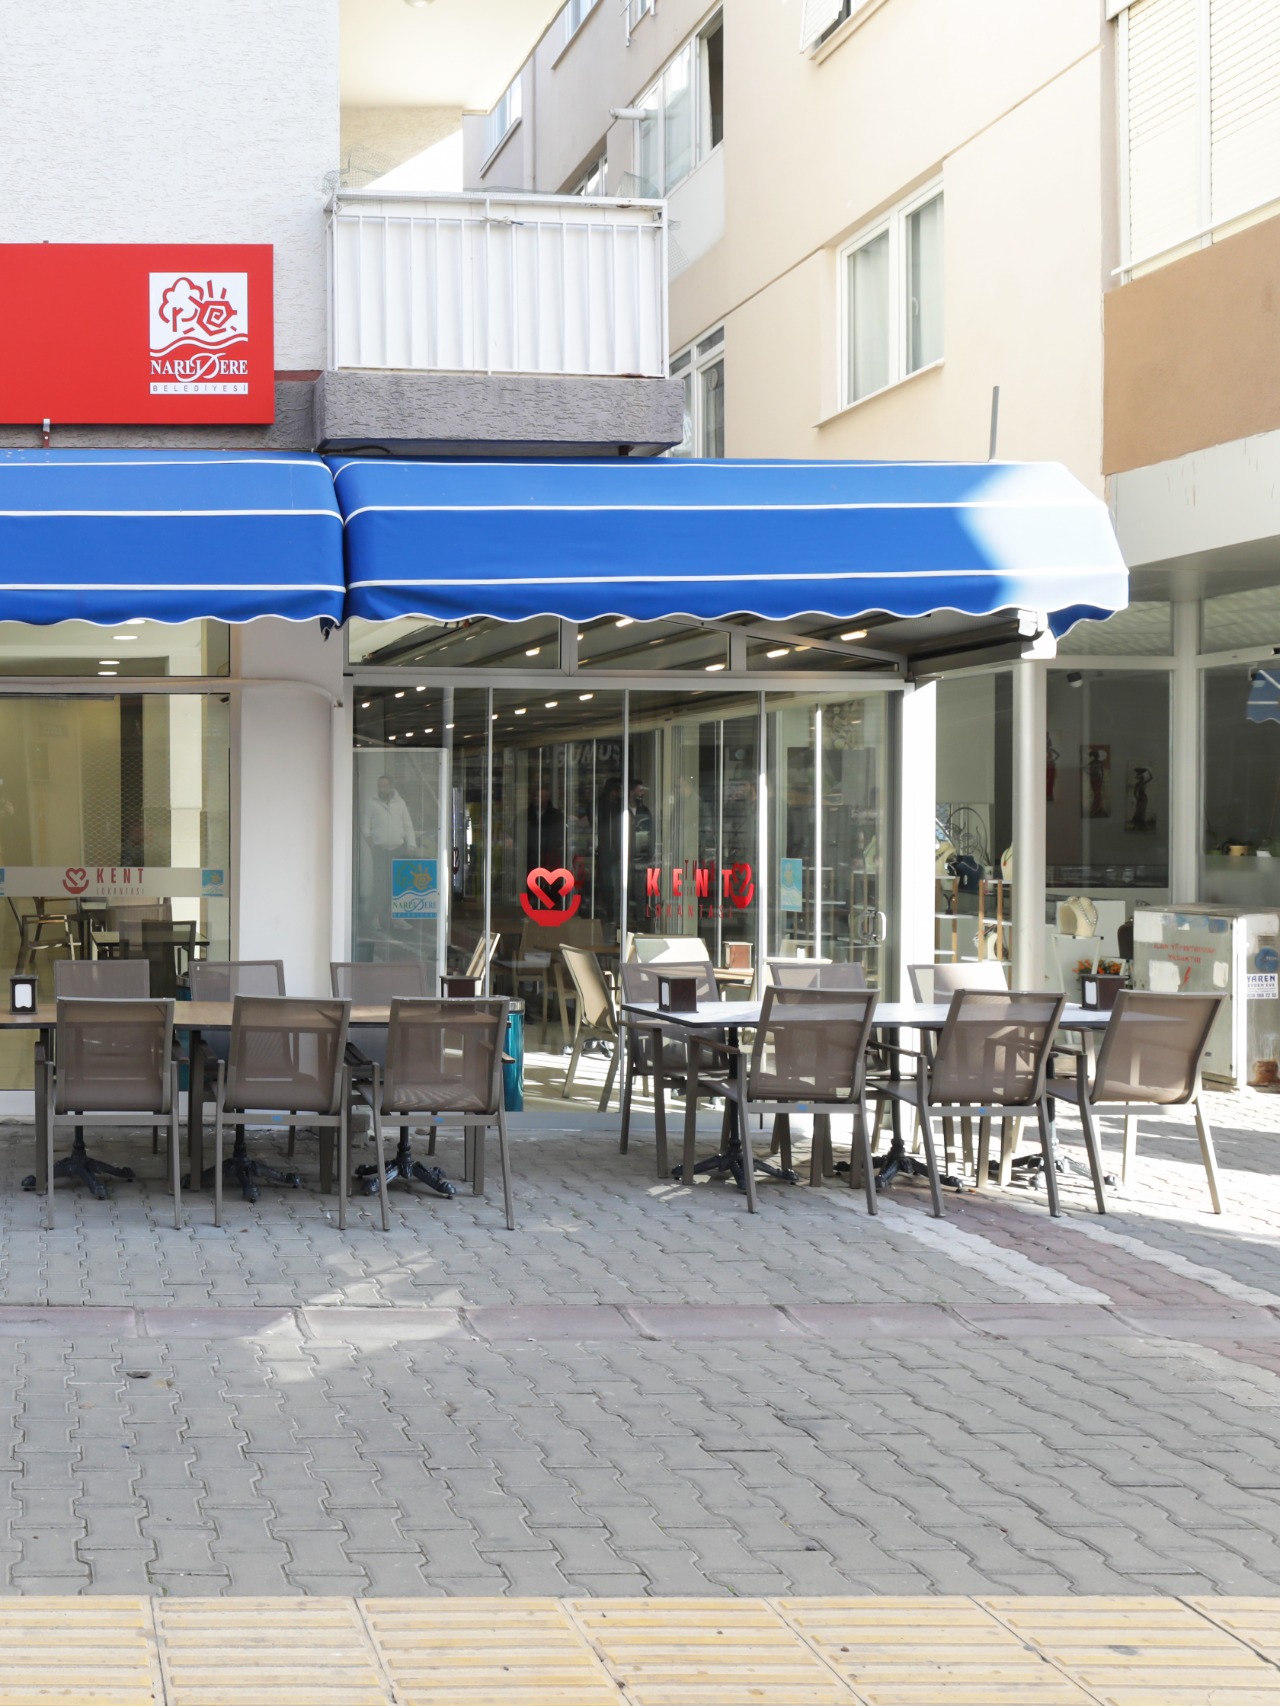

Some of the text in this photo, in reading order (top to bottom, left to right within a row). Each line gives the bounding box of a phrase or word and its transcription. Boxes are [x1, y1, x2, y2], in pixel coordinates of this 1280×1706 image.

[149, 351, 248, 382] NARLIDERE
[152, 384, 248, 392] BELEDİYESİ
[96, 868, 144, 884] KENT
[646, 868, 733, 898] KENT
[646, 903, 733, 919] LOKANTASI
[1246, 975, 1276, 983] YAREN
